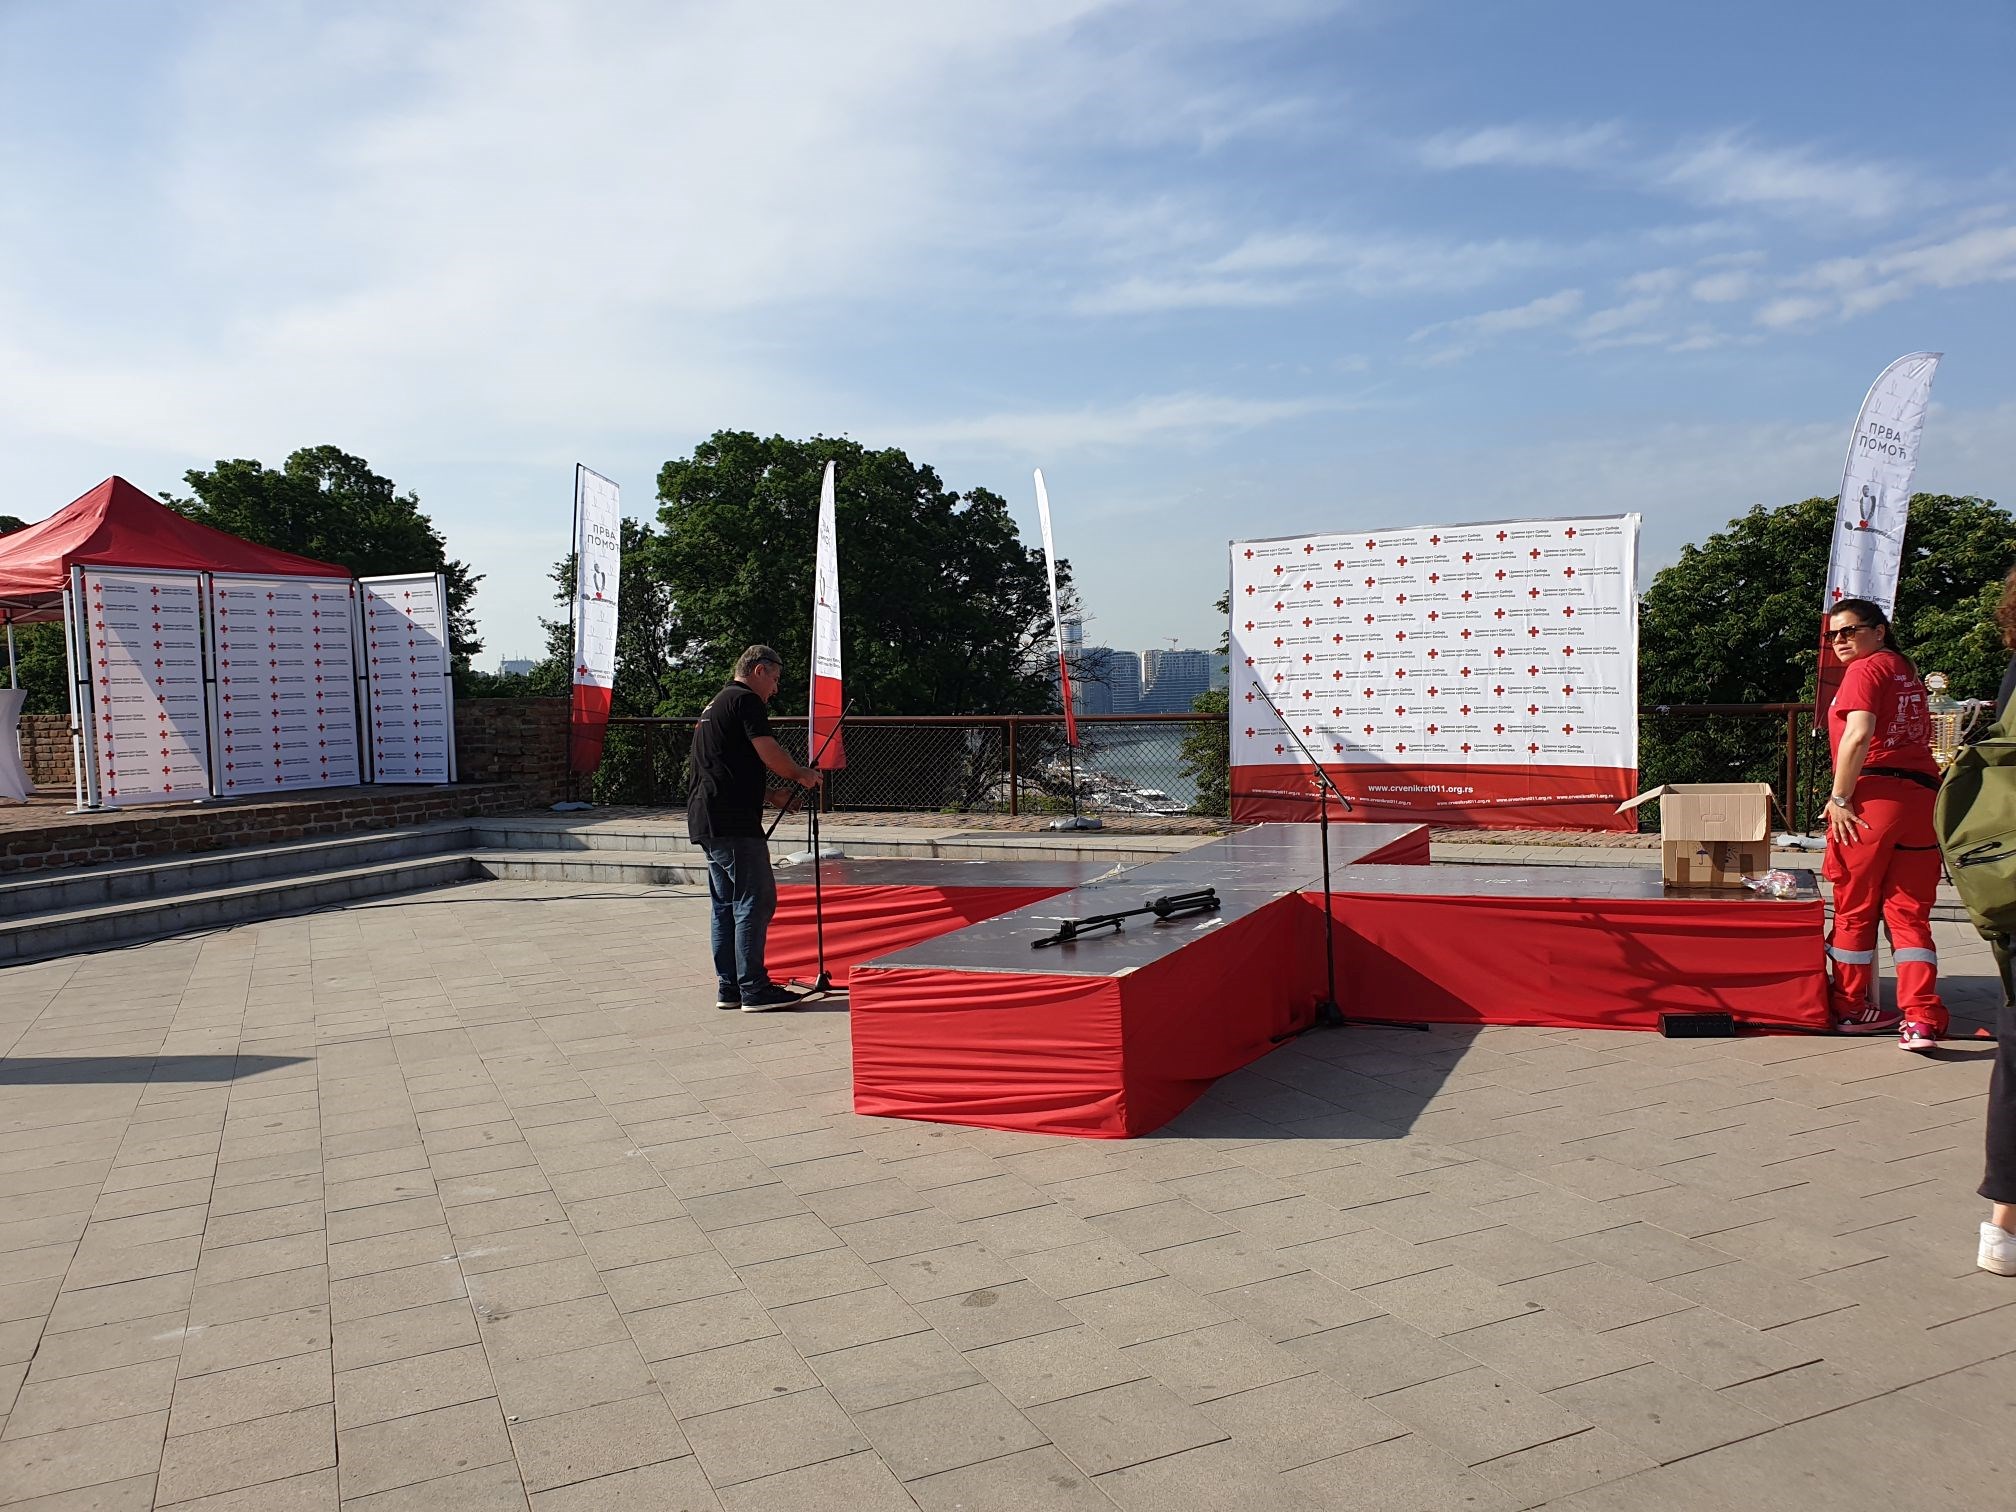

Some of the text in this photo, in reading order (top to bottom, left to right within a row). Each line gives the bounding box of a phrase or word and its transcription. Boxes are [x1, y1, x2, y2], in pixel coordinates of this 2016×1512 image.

[1869, 422, 1901, 443] ПРВА
[1859, 435, 1906, 460] ПОМОЋ
[593, 524, 616, 541] ПРВА
[1368, 785, 1474, 794] www.crvenikrst011.org.rs
